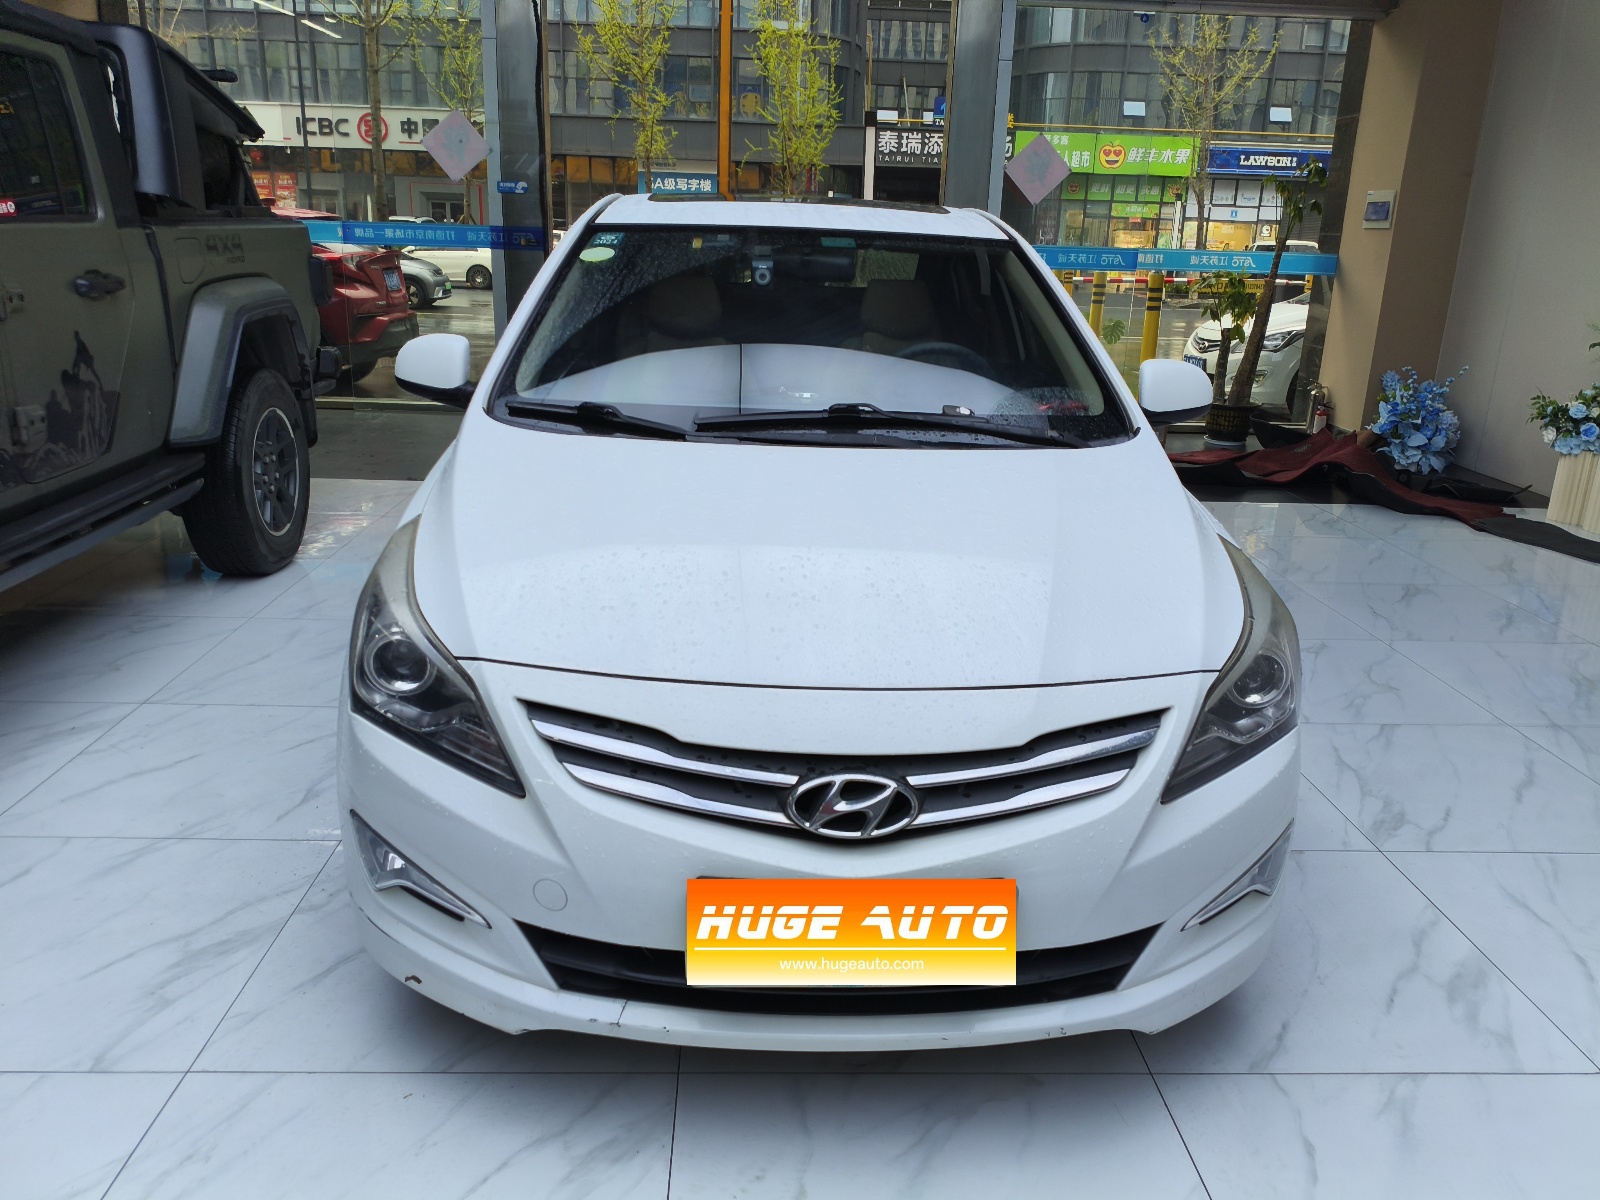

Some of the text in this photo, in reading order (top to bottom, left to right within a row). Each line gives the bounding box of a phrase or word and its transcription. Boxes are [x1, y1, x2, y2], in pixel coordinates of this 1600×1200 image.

[296, 117, 350, 137] ICBC
[1126, 146, 1191, 165] 鲜丰水果
[1240, 154, 1292, 167] LAWSON
